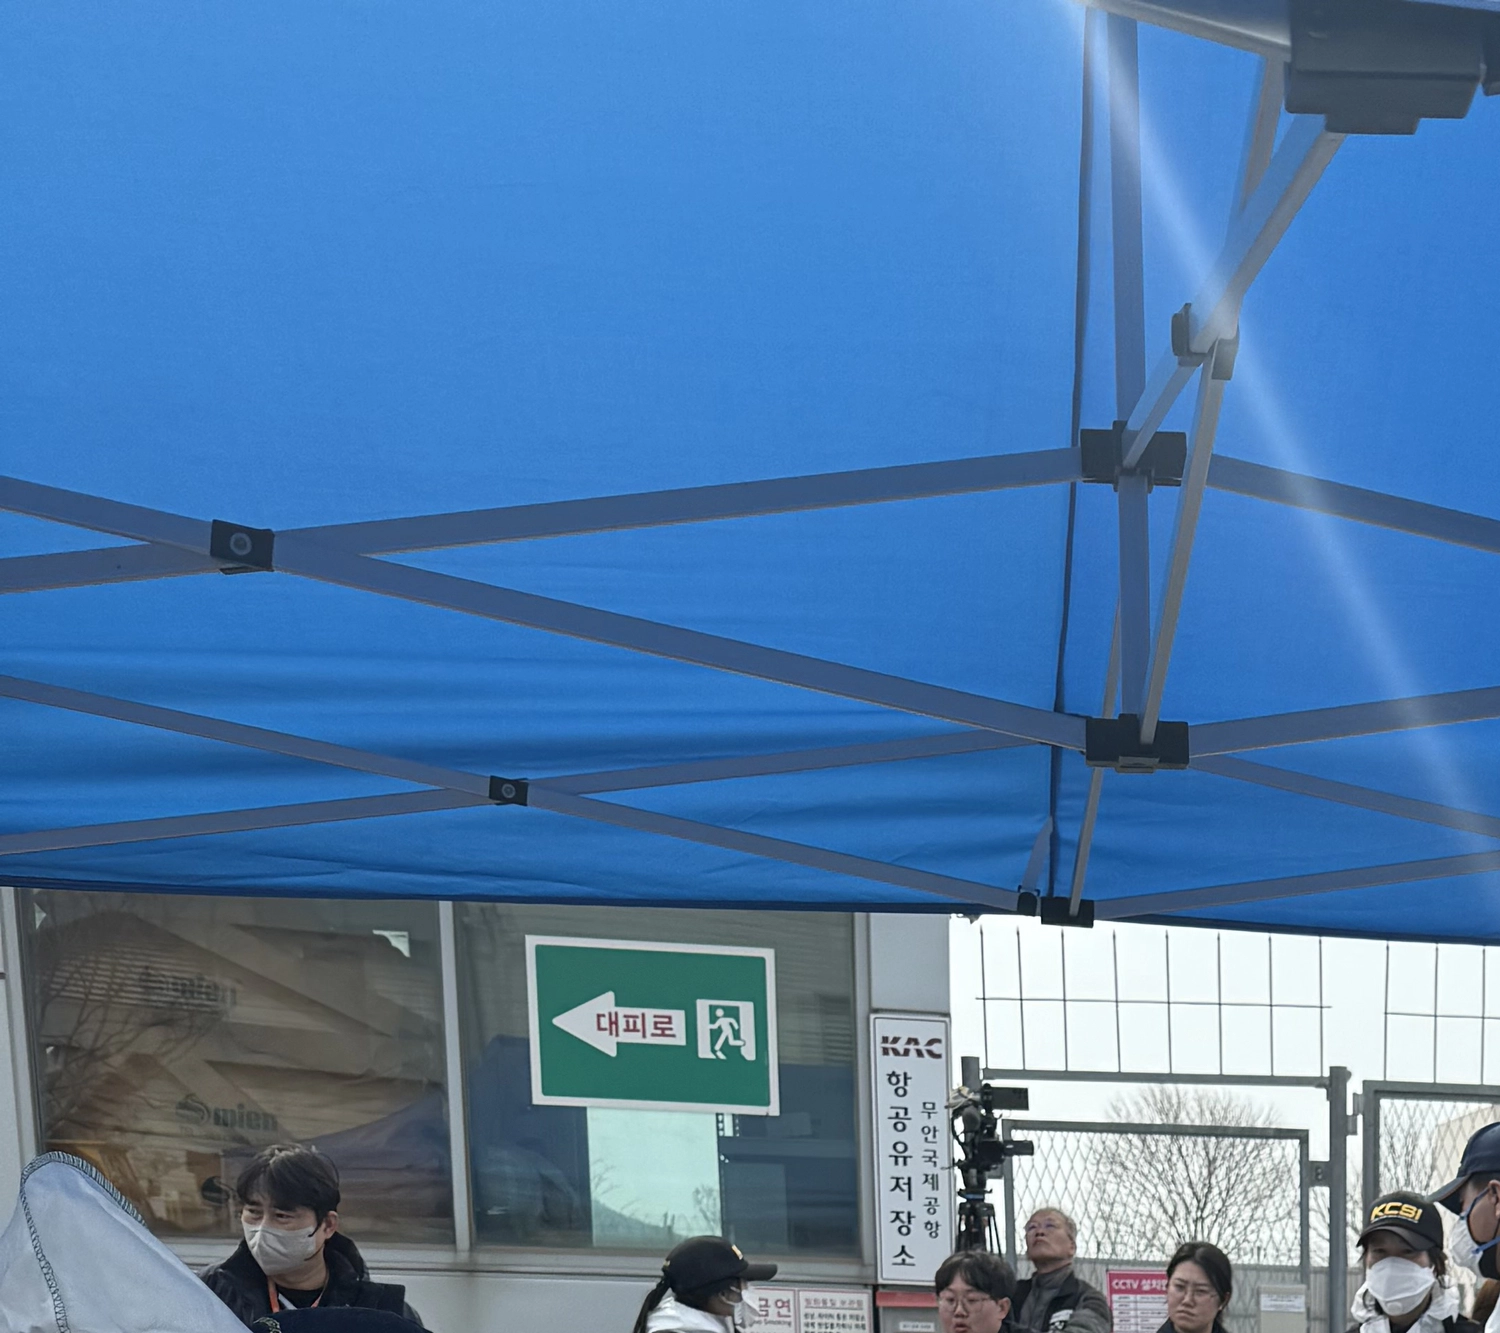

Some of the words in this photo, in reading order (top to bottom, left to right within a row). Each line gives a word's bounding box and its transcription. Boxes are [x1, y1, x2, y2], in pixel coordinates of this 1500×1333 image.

[596, 1011, 677, 1039] 대피로
[881, 1035, 943, 1059] KAC
[886, 1070, 916, 1267] 항공유저장소
[920, 1101, 942, 1239] 무안국제공항
[1371, 1202, 1422, 1222] KCSI
[1112, 1279, 1139, 1289] CCTV
[758, 1297, 792, 1318] 금연
